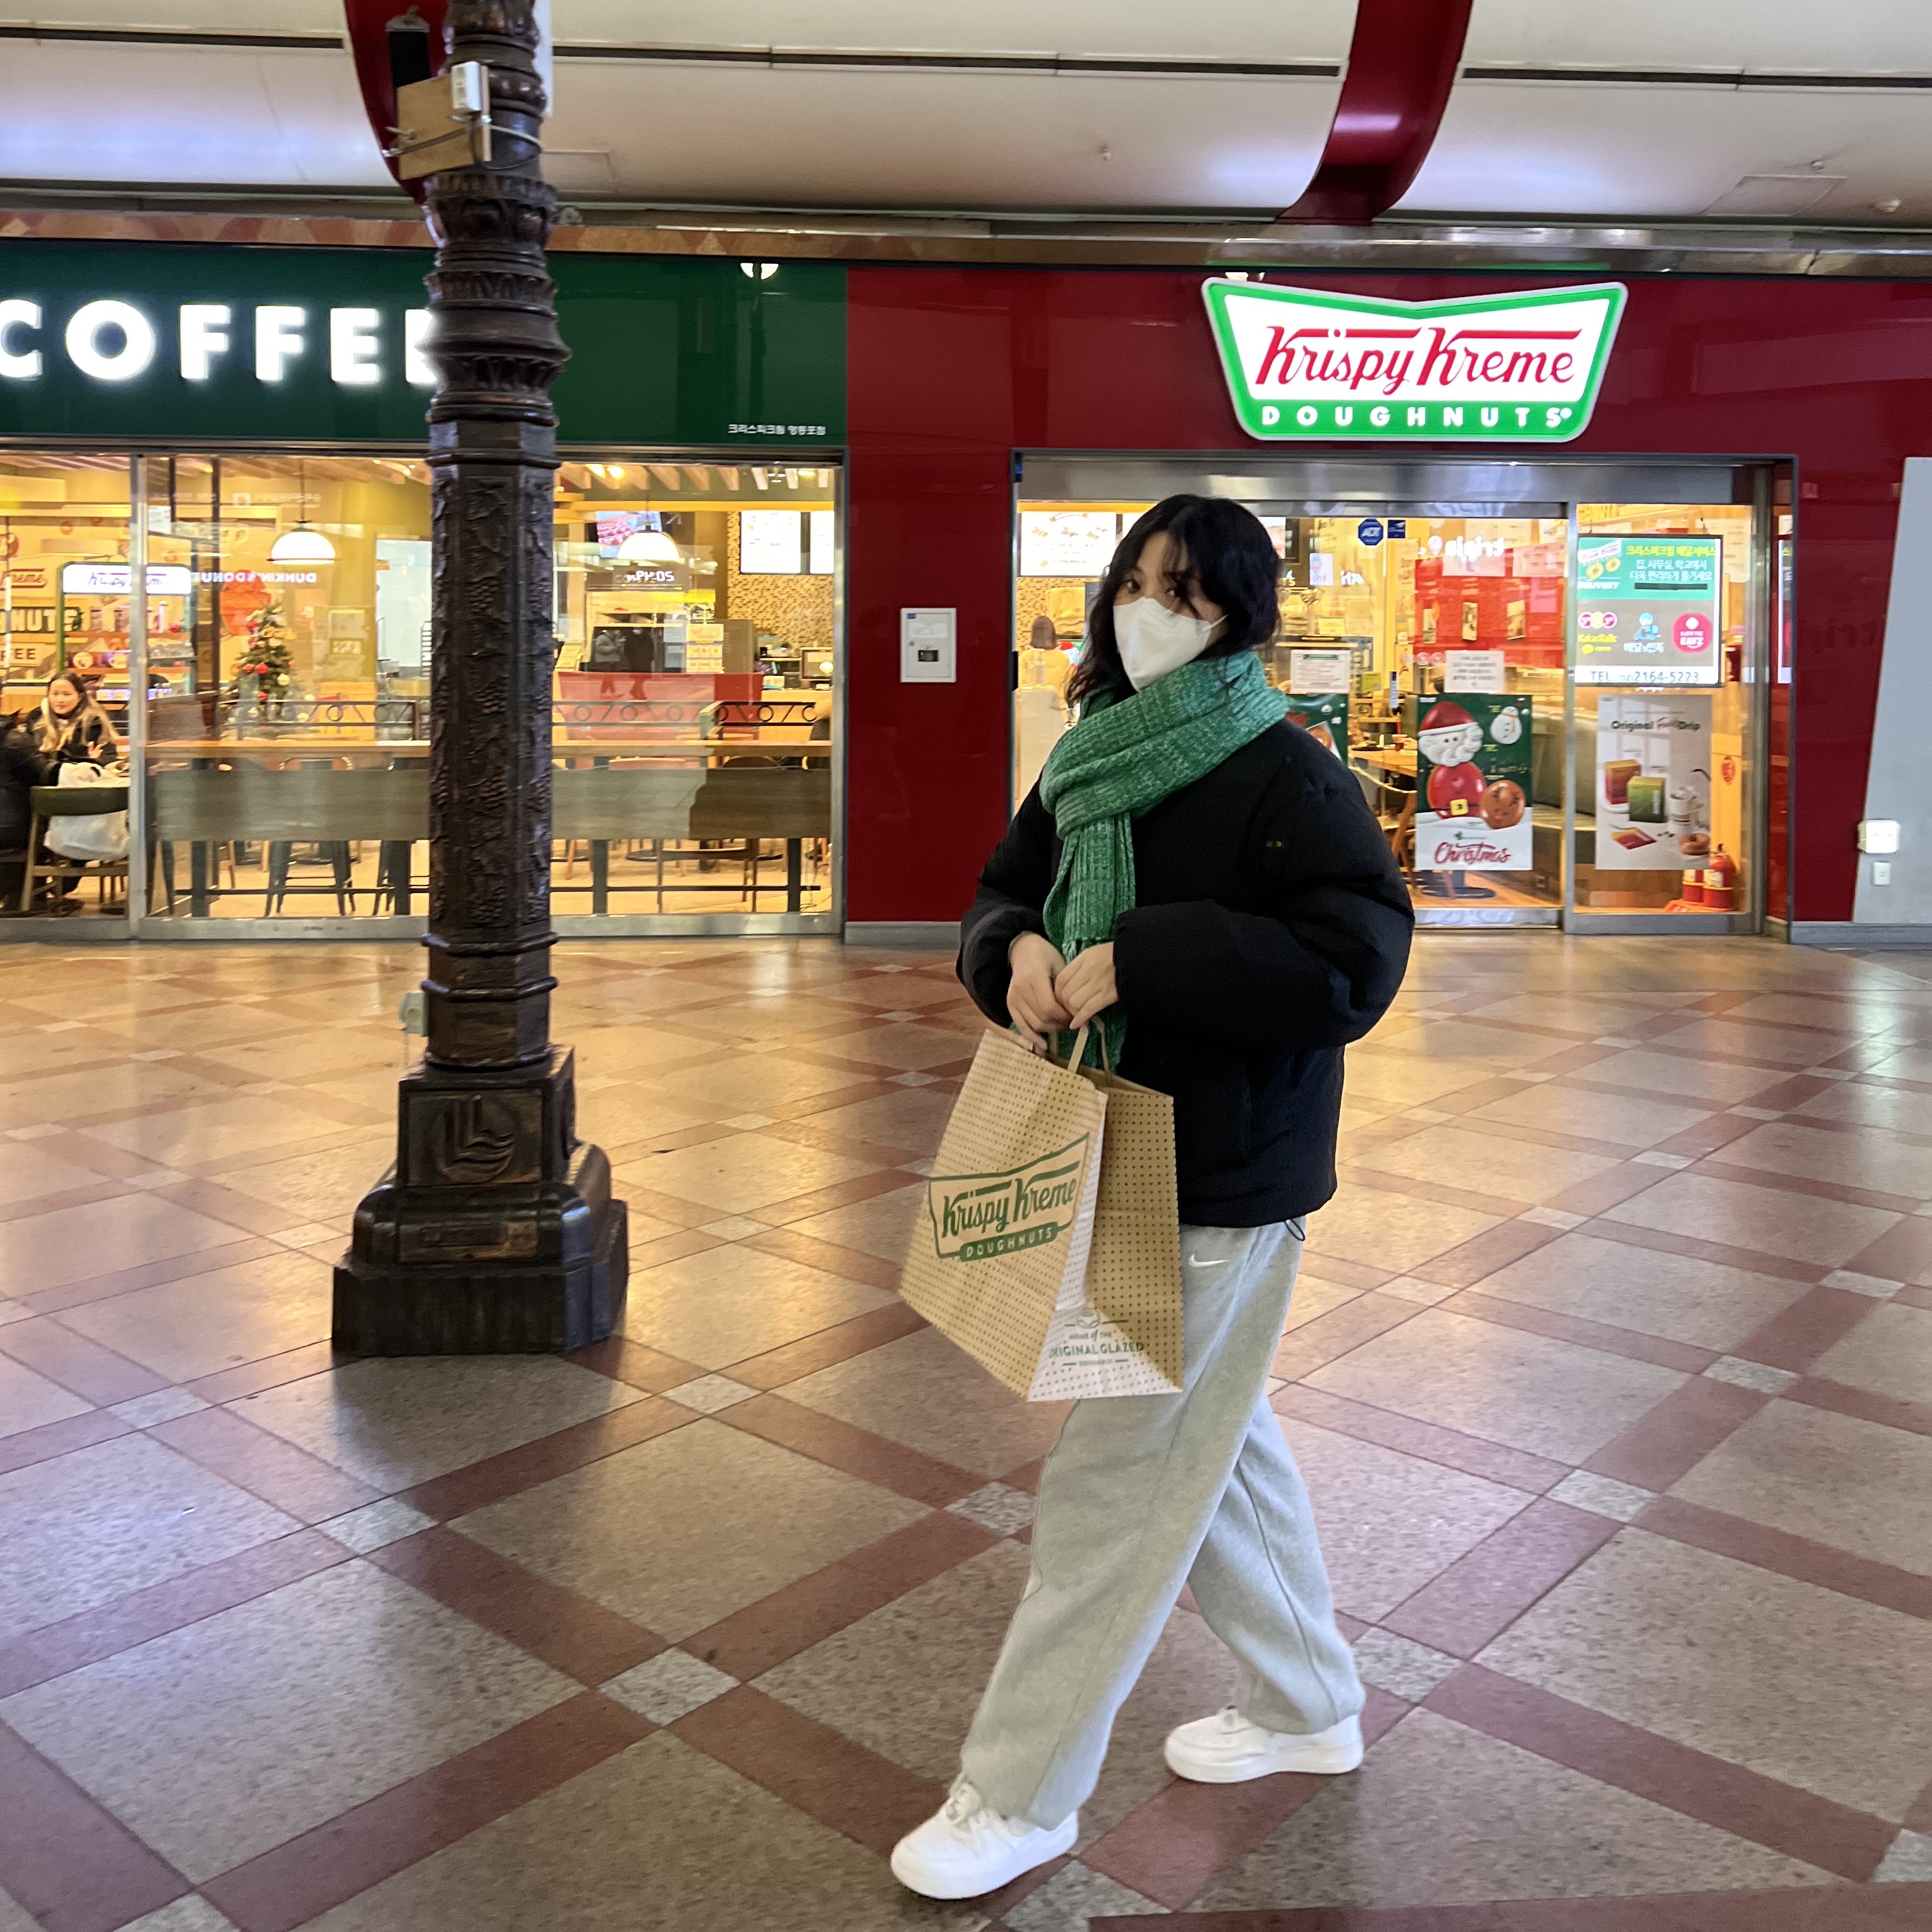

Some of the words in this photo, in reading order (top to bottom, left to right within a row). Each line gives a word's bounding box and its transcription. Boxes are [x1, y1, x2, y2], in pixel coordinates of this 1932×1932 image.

[1255, 326, 1422, 395] Krispy
[1416, 326, 1583, 386] Kreme
[1262, 406, 1563, 427] DOUGHNUTS
[1611, 720, 1654, 733] Original
[1434, 841, 1511, 864] Christmas
[942, 1179, 1013, 1238] Krispy
[1013, 1160, 1081, 1222] Kreme
[965, 1227, 1053, 1258] DOUGHNUTS
[1100, 1342, 1145, 1354] GLAZED
